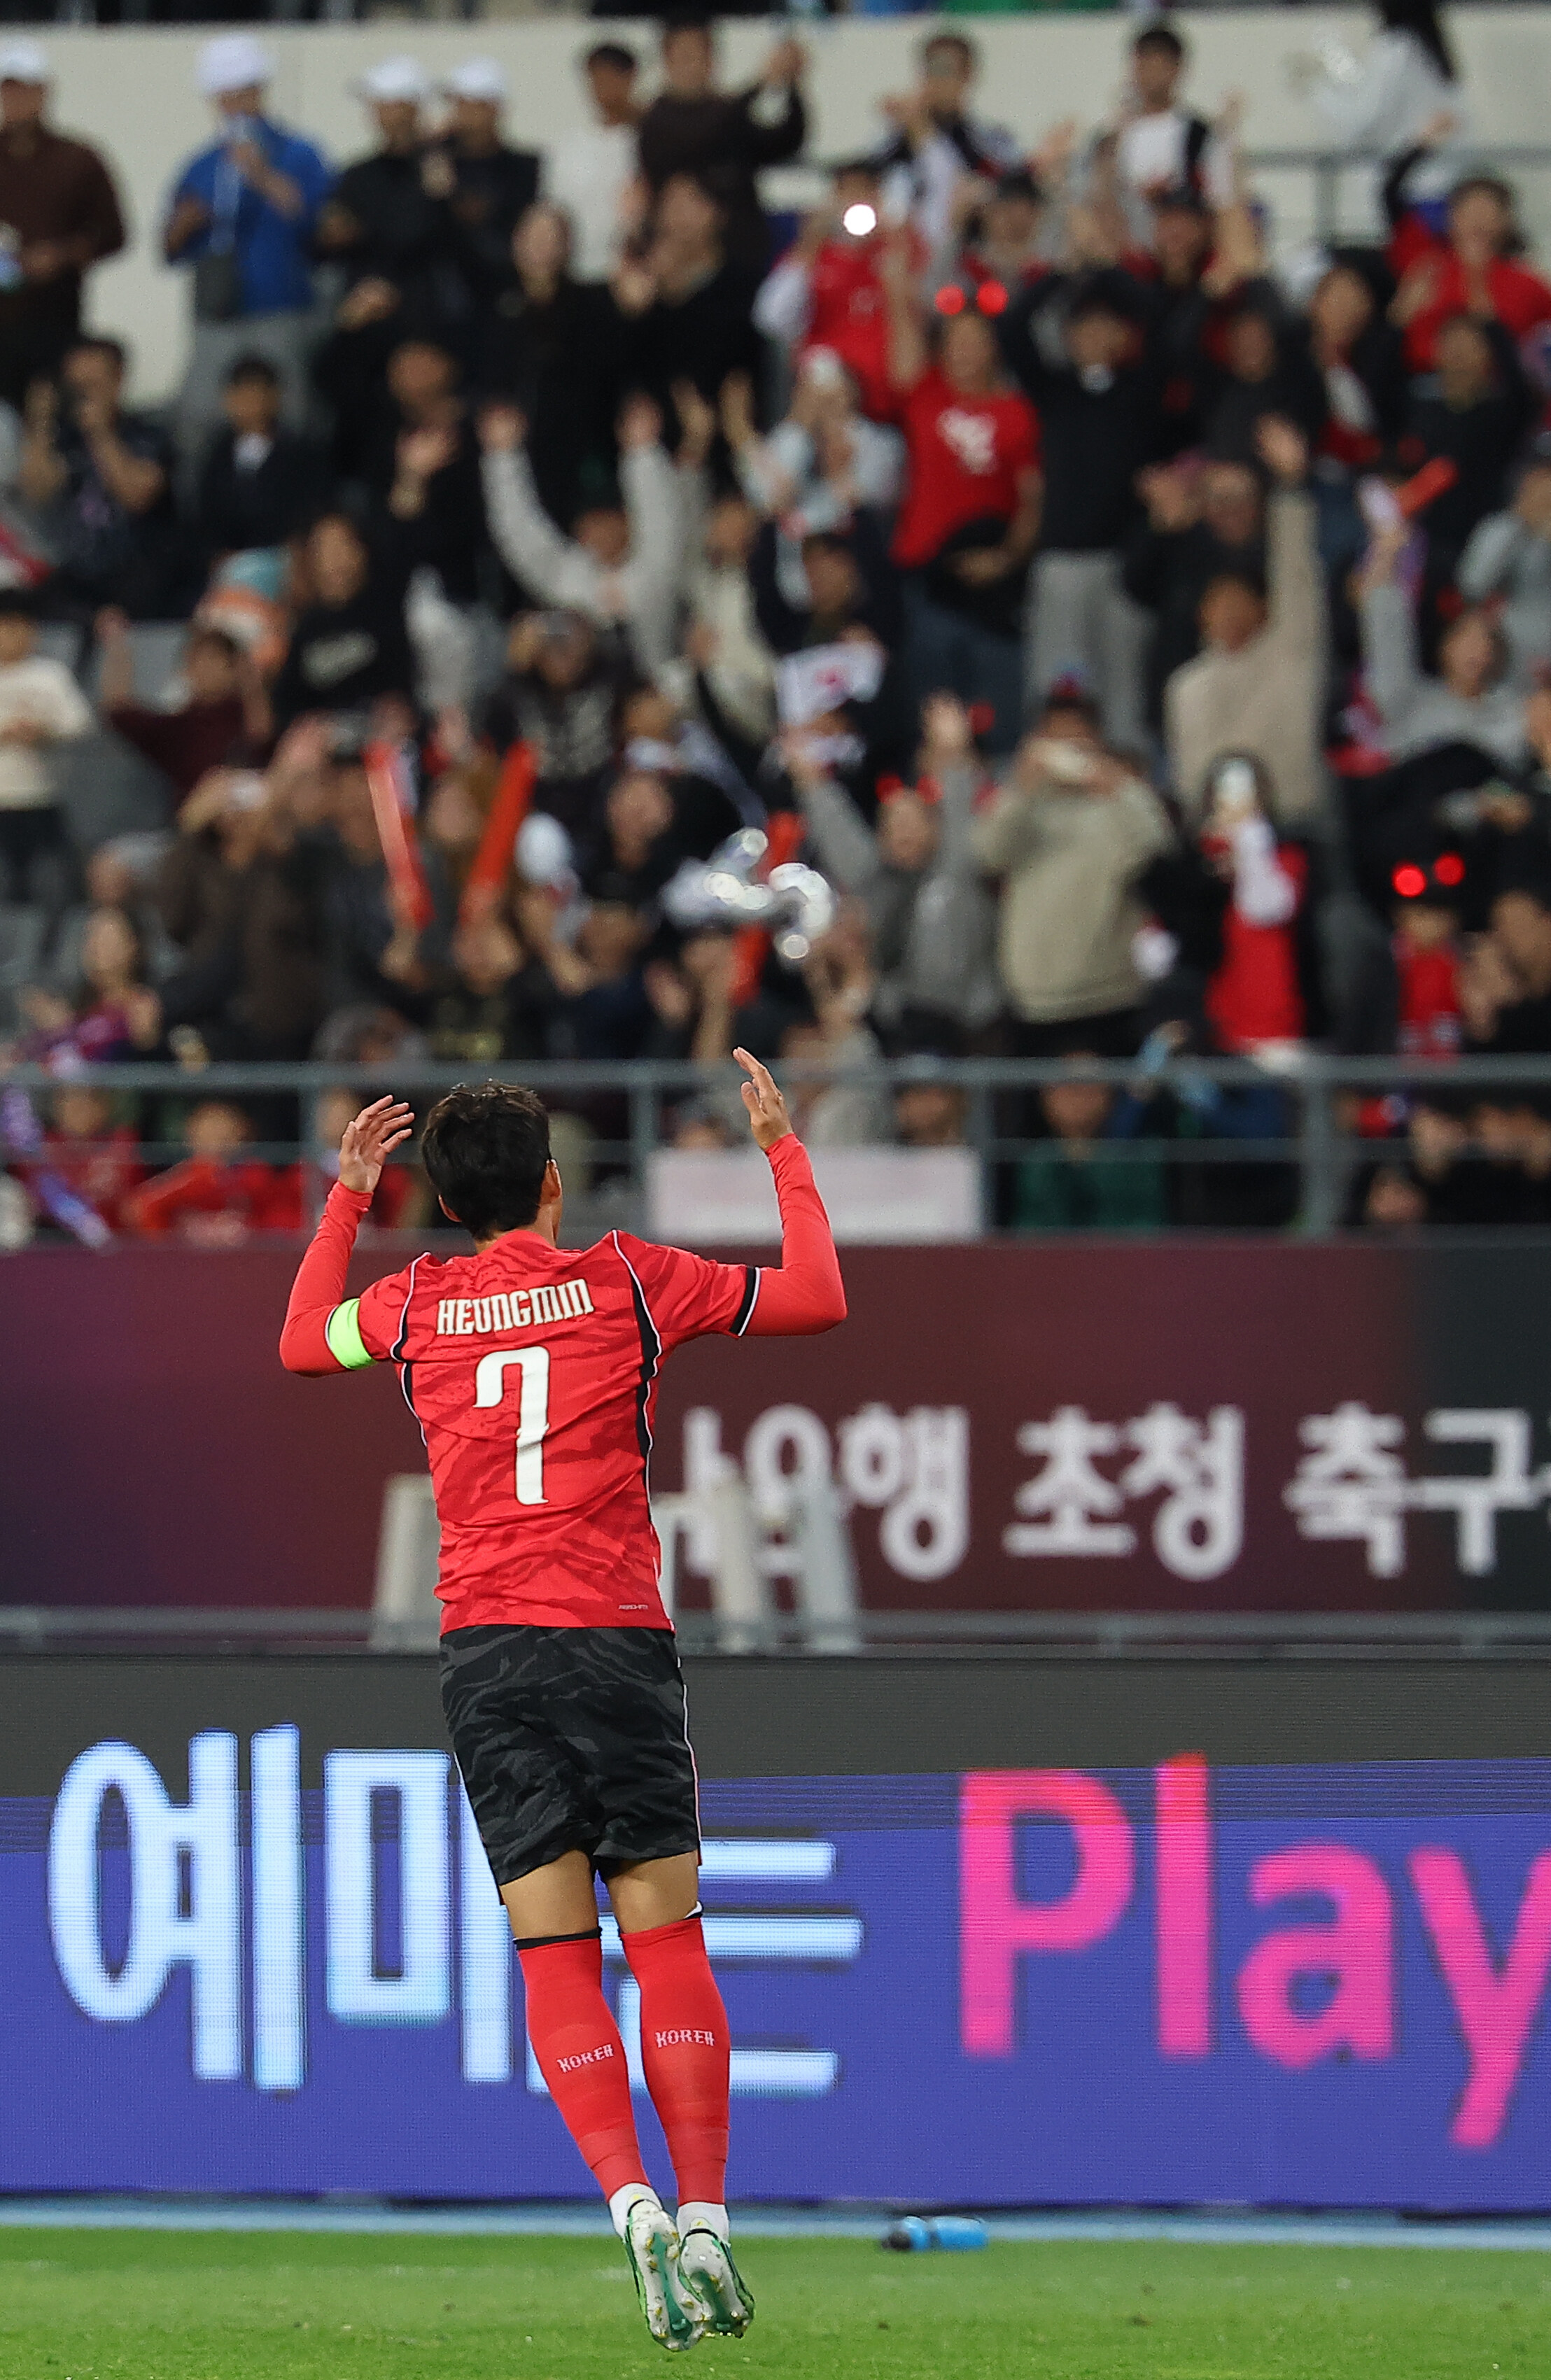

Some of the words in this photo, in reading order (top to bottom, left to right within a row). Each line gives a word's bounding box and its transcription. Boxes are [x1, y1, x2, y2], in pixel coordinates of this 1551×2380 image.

[436, 1278, 594, 1335] HEUNGMIN
[472, 1346, 549, 1505] 7
[1003, 1402, 1246, 1582] 초청
[1284, 1402, 1551, 1580] 축구
[958, 1749, 1551, 2152] Play
[557, 2044, 614, 2073] KOREA
[655, 2029, 715, 2048] KOREA
